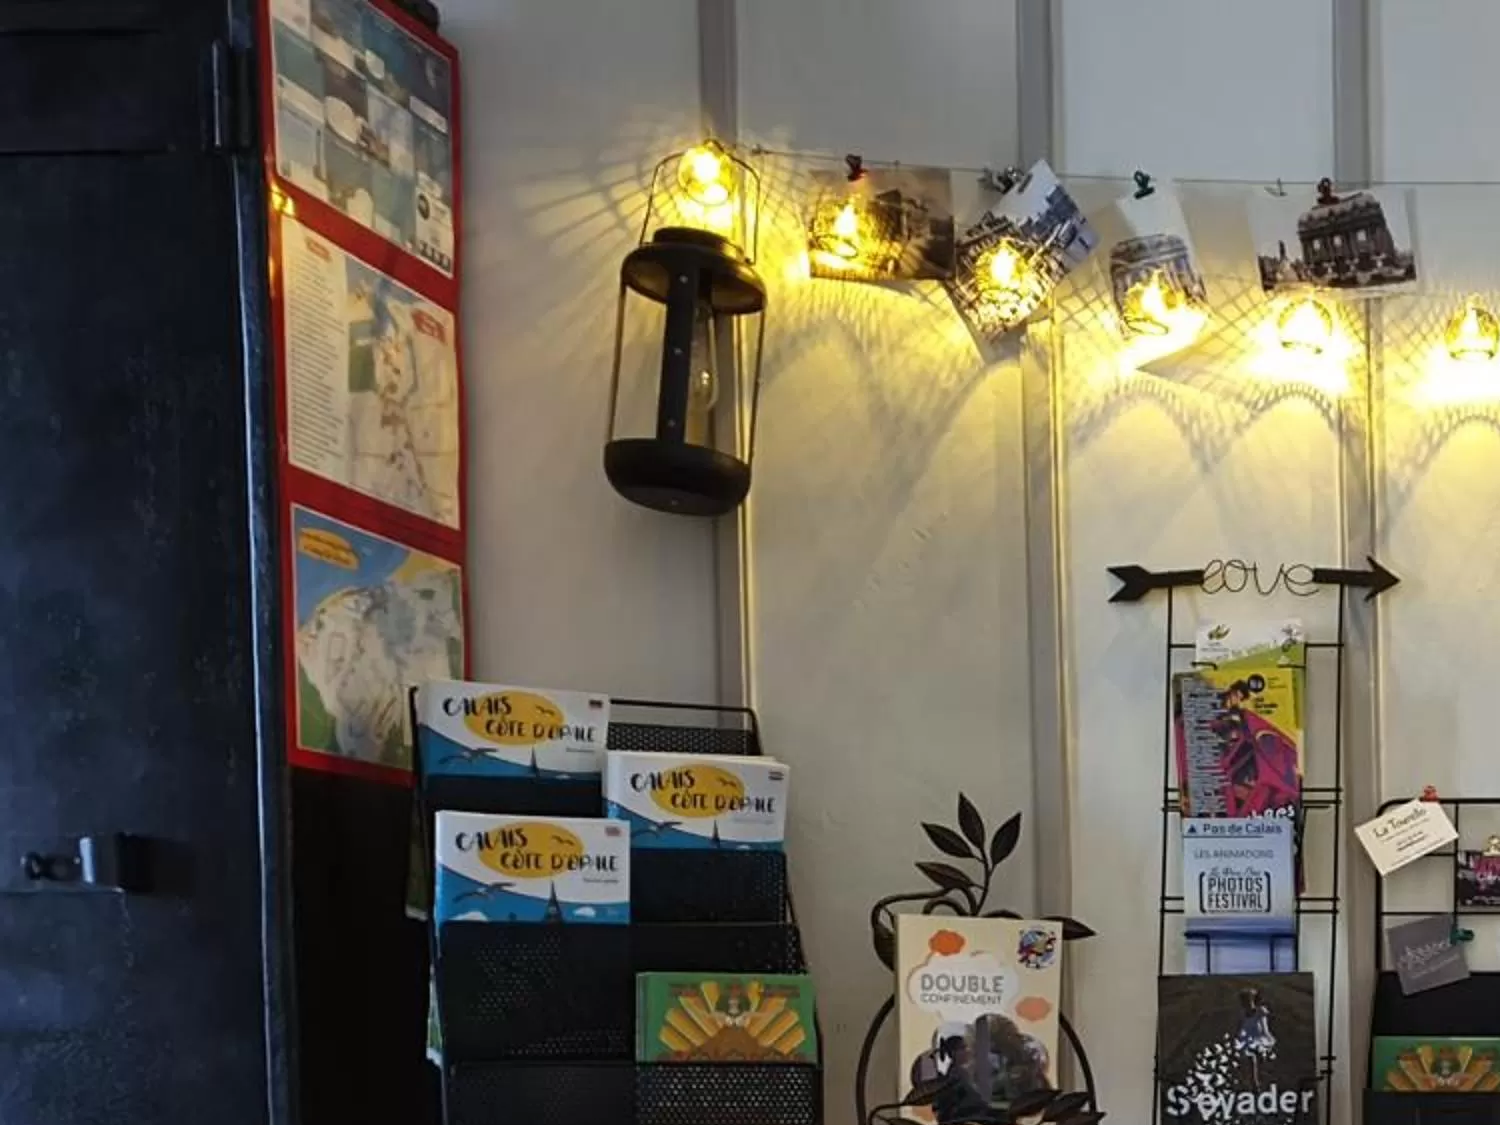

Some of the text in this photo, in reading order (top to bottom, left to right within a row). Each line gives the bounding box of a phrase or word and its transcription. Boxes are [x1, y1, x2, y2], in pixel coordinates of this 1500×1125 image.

[1207, 877, 1264, 893] PHOTOS
[1207, 893, 1264, 909] FESTIVAL
[920, 973, 1005, 993] DOUBLE
